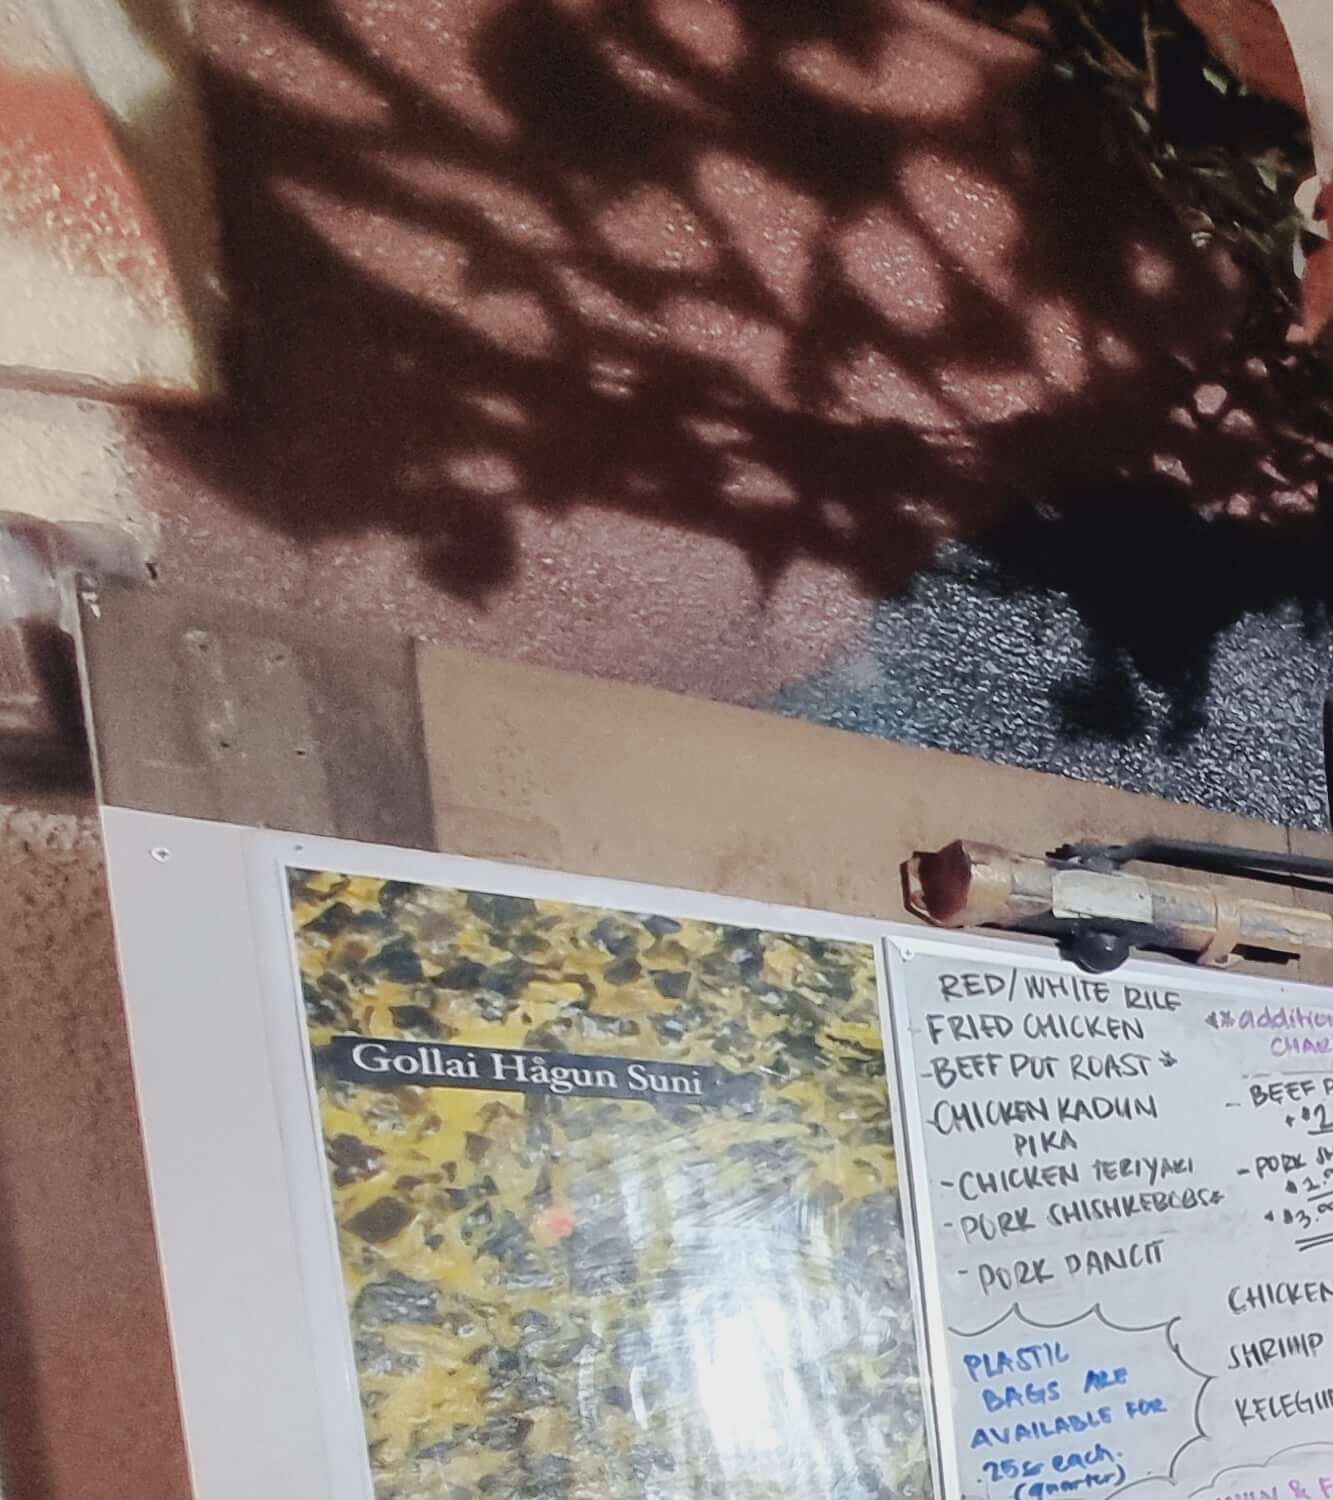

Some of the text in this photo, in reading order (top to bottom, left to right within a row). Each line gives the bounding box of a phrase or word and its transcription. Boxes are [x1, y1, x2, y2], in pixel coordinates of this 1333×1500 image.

[938, 967, 1110, 1003] RED/WHITE
[926, 1013, 1146, 1044] FRIED CHICKEN
[352, 1043, 703, 1096] Gollai Hågun Suni
[1250, 1079, 1316, 1108] BEEF
[1013, 1129, 1078, 1157] PIKA
[1092, 1157, 1193, 1186] TERIYAKI
[963, 1342, 1070, 1383] PLASTIC
[1228, 1333, 1325, 1370] SHRIMP
[982, 1367, 1129, 1413] BAGS ARE
[970, 1397, 1168, 1449] AVAILABLE FOR
[1288, 1479, 1311, 1500] &
